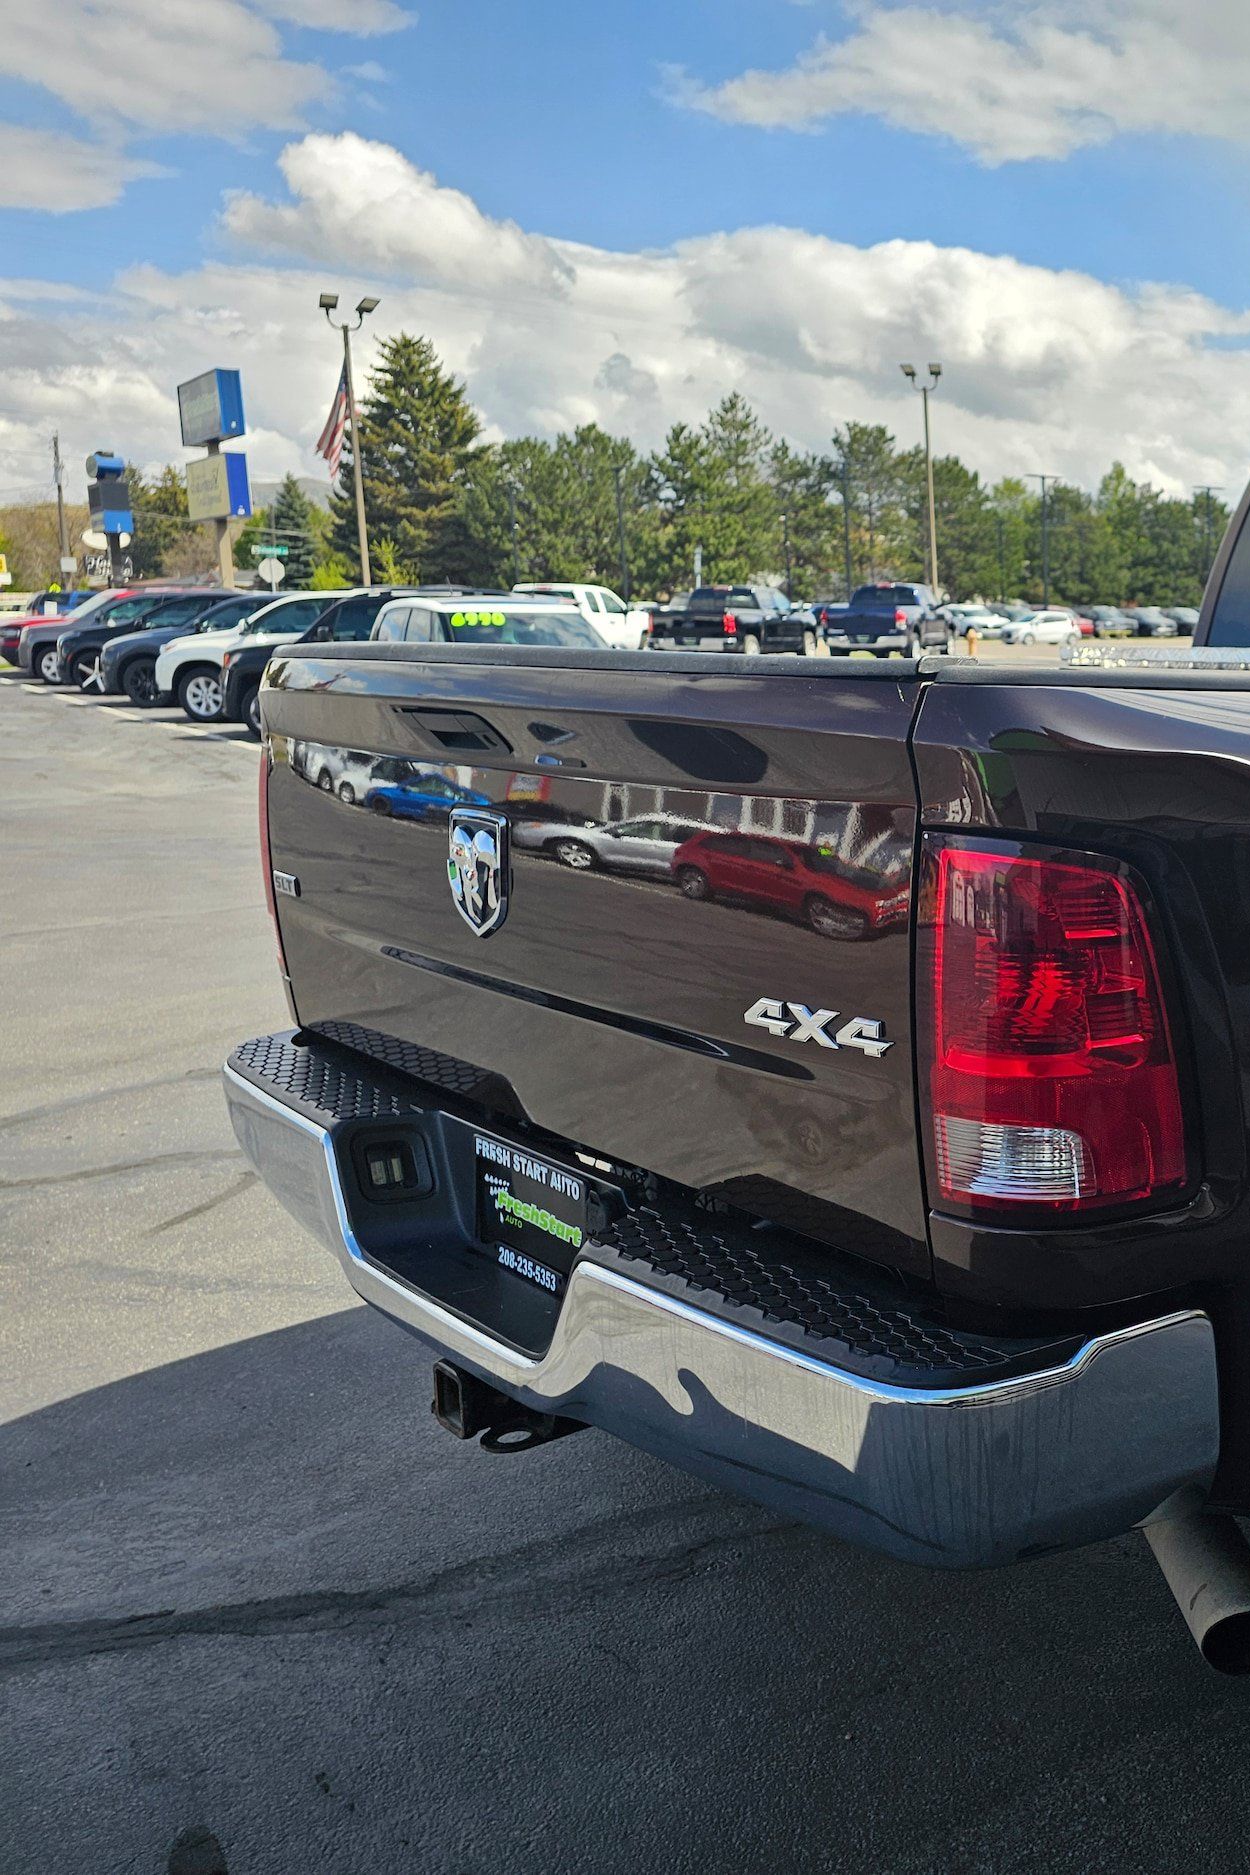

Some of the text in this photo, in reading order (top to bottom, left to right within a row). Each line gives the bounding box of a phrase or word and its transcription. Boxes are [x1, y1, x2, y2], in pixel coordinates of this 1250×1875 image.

[475, 1138, 580, 1201] FRESH START AUTO
[505, 1215, 523, 1229] AUTO
[498, 1247, 557, 1291] 208-235-5353
